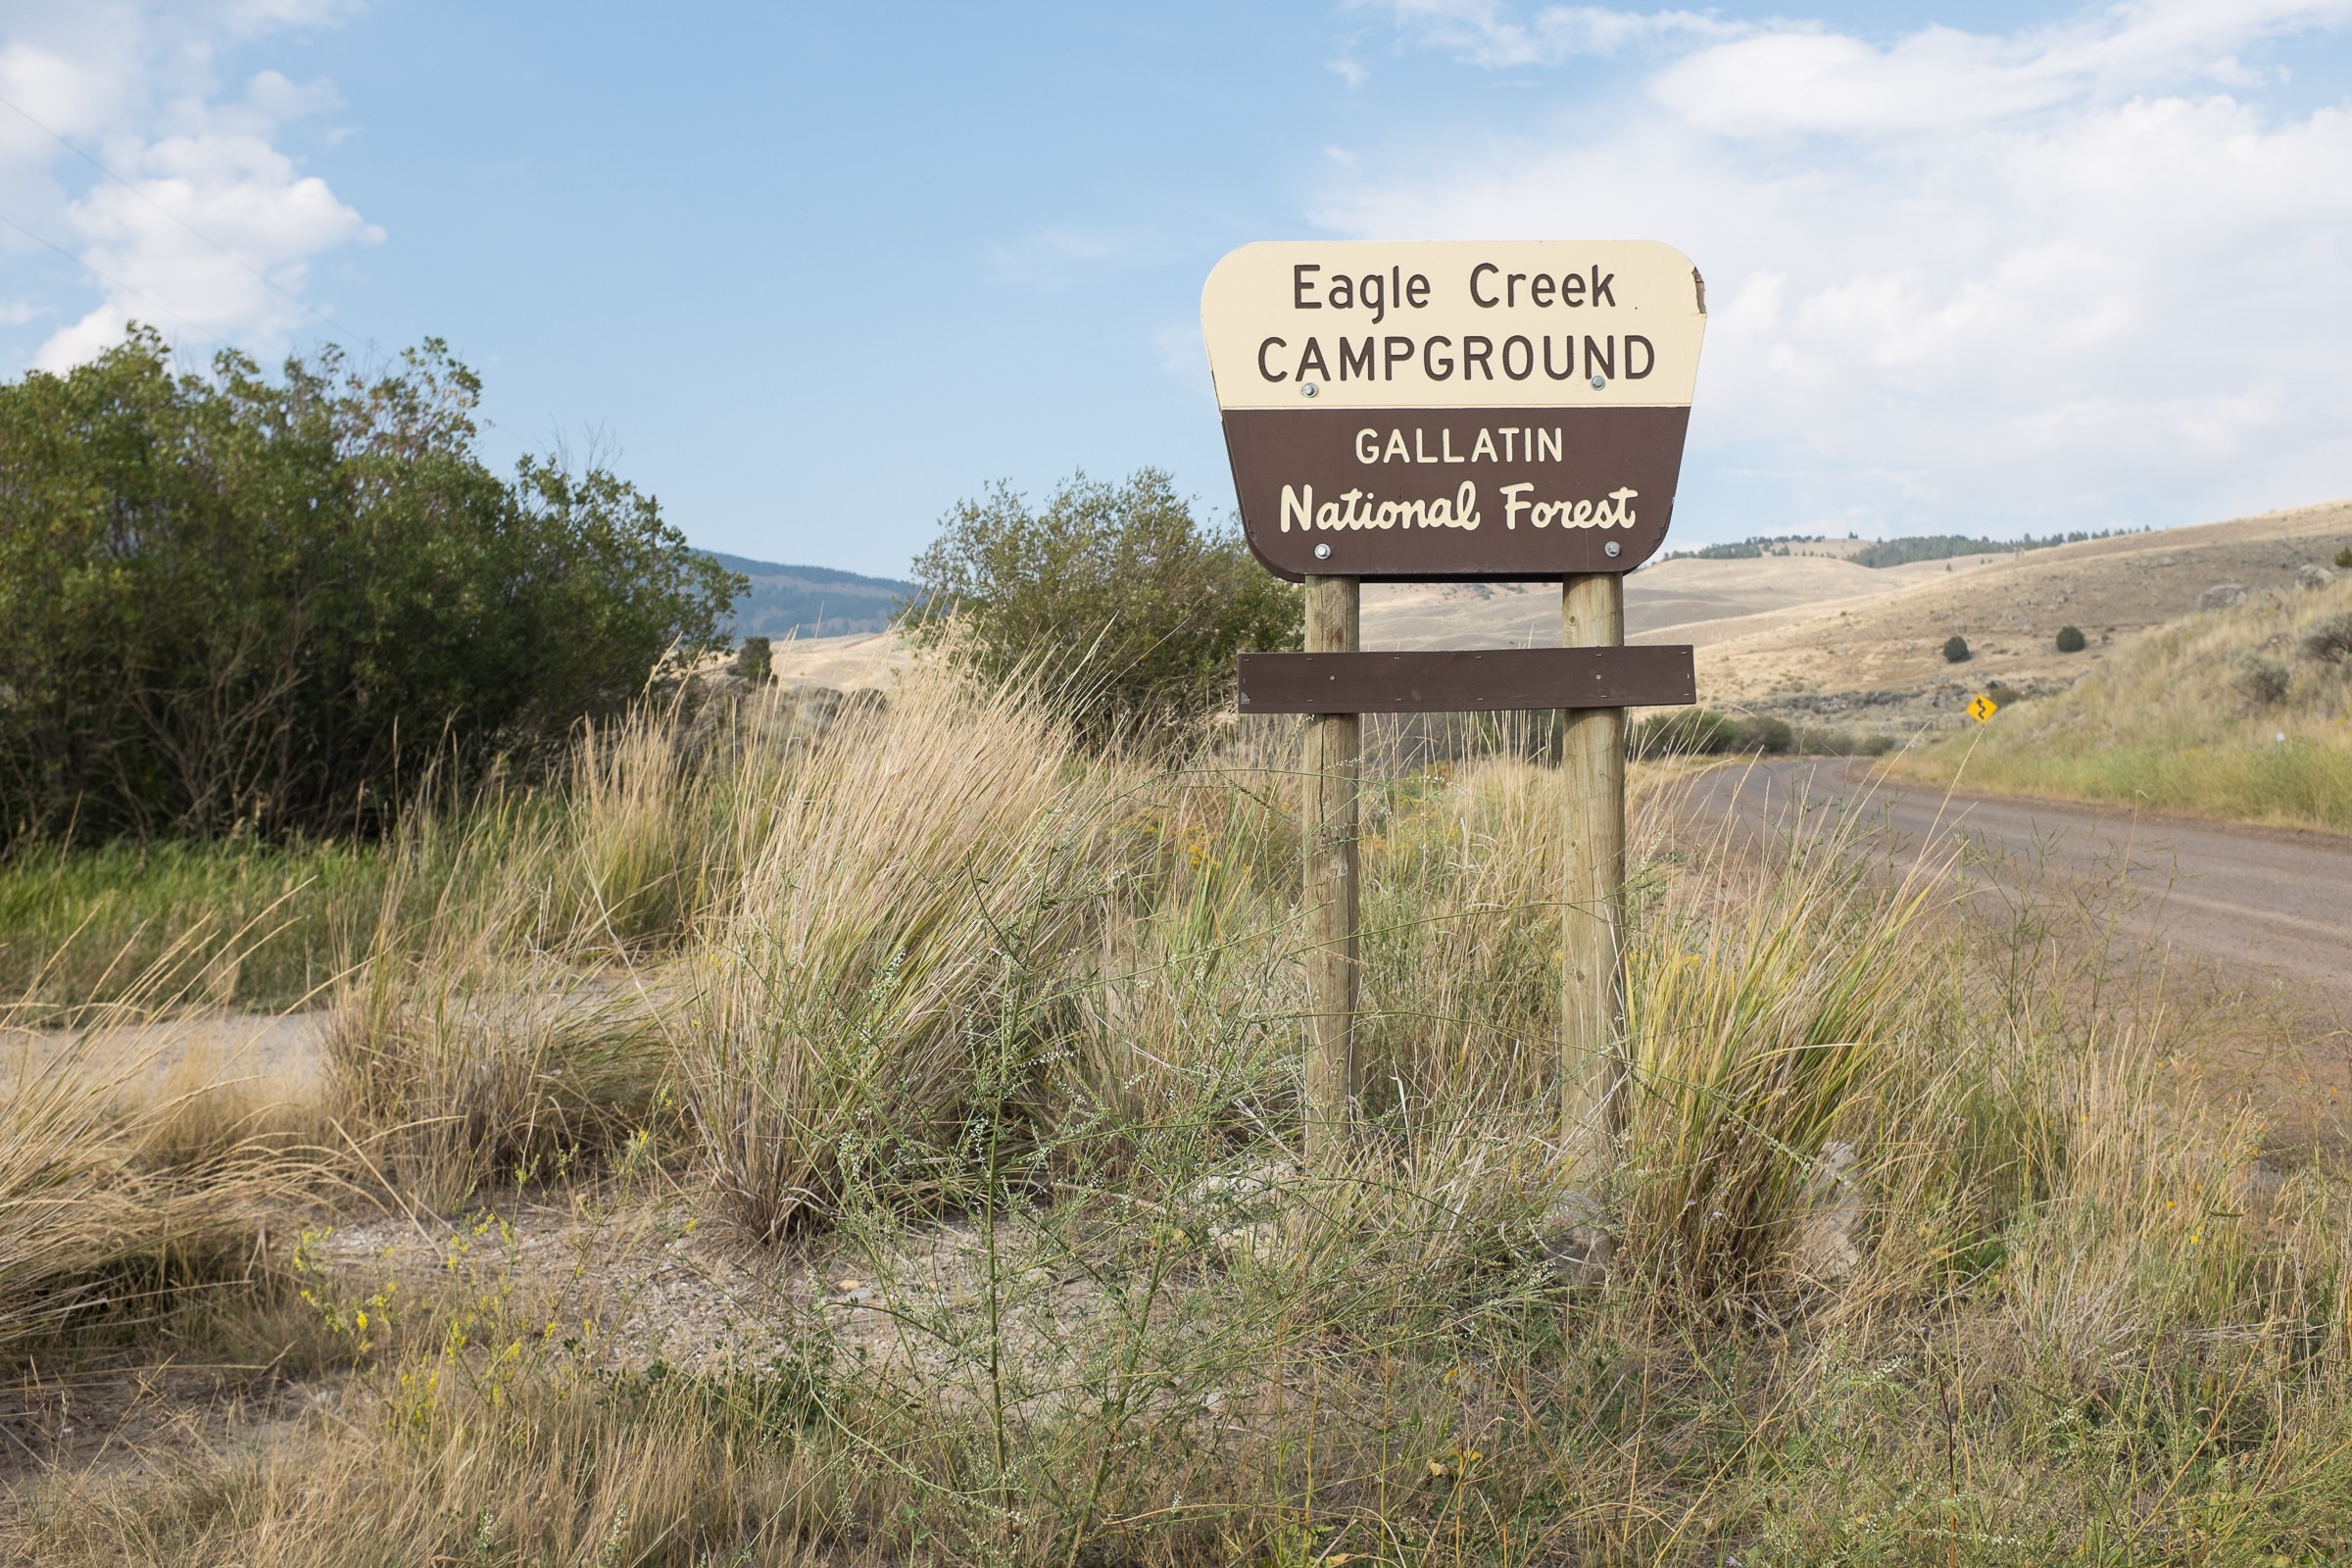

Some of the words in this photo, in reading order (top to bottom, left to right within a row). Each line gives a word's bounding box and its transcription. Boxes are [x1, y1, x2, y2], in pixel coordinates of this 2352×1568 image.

[1294, 264, 1431, 324] Eagle
[1470, 263, 1616, 309] Creek
[1258, 335, 1655, 382] CAMPGROUND
[1355, 427, 1563, 465] GALLATIN
[1280, 481, 1481, 533] National
[1499, 482, 1638, 530] Forest
